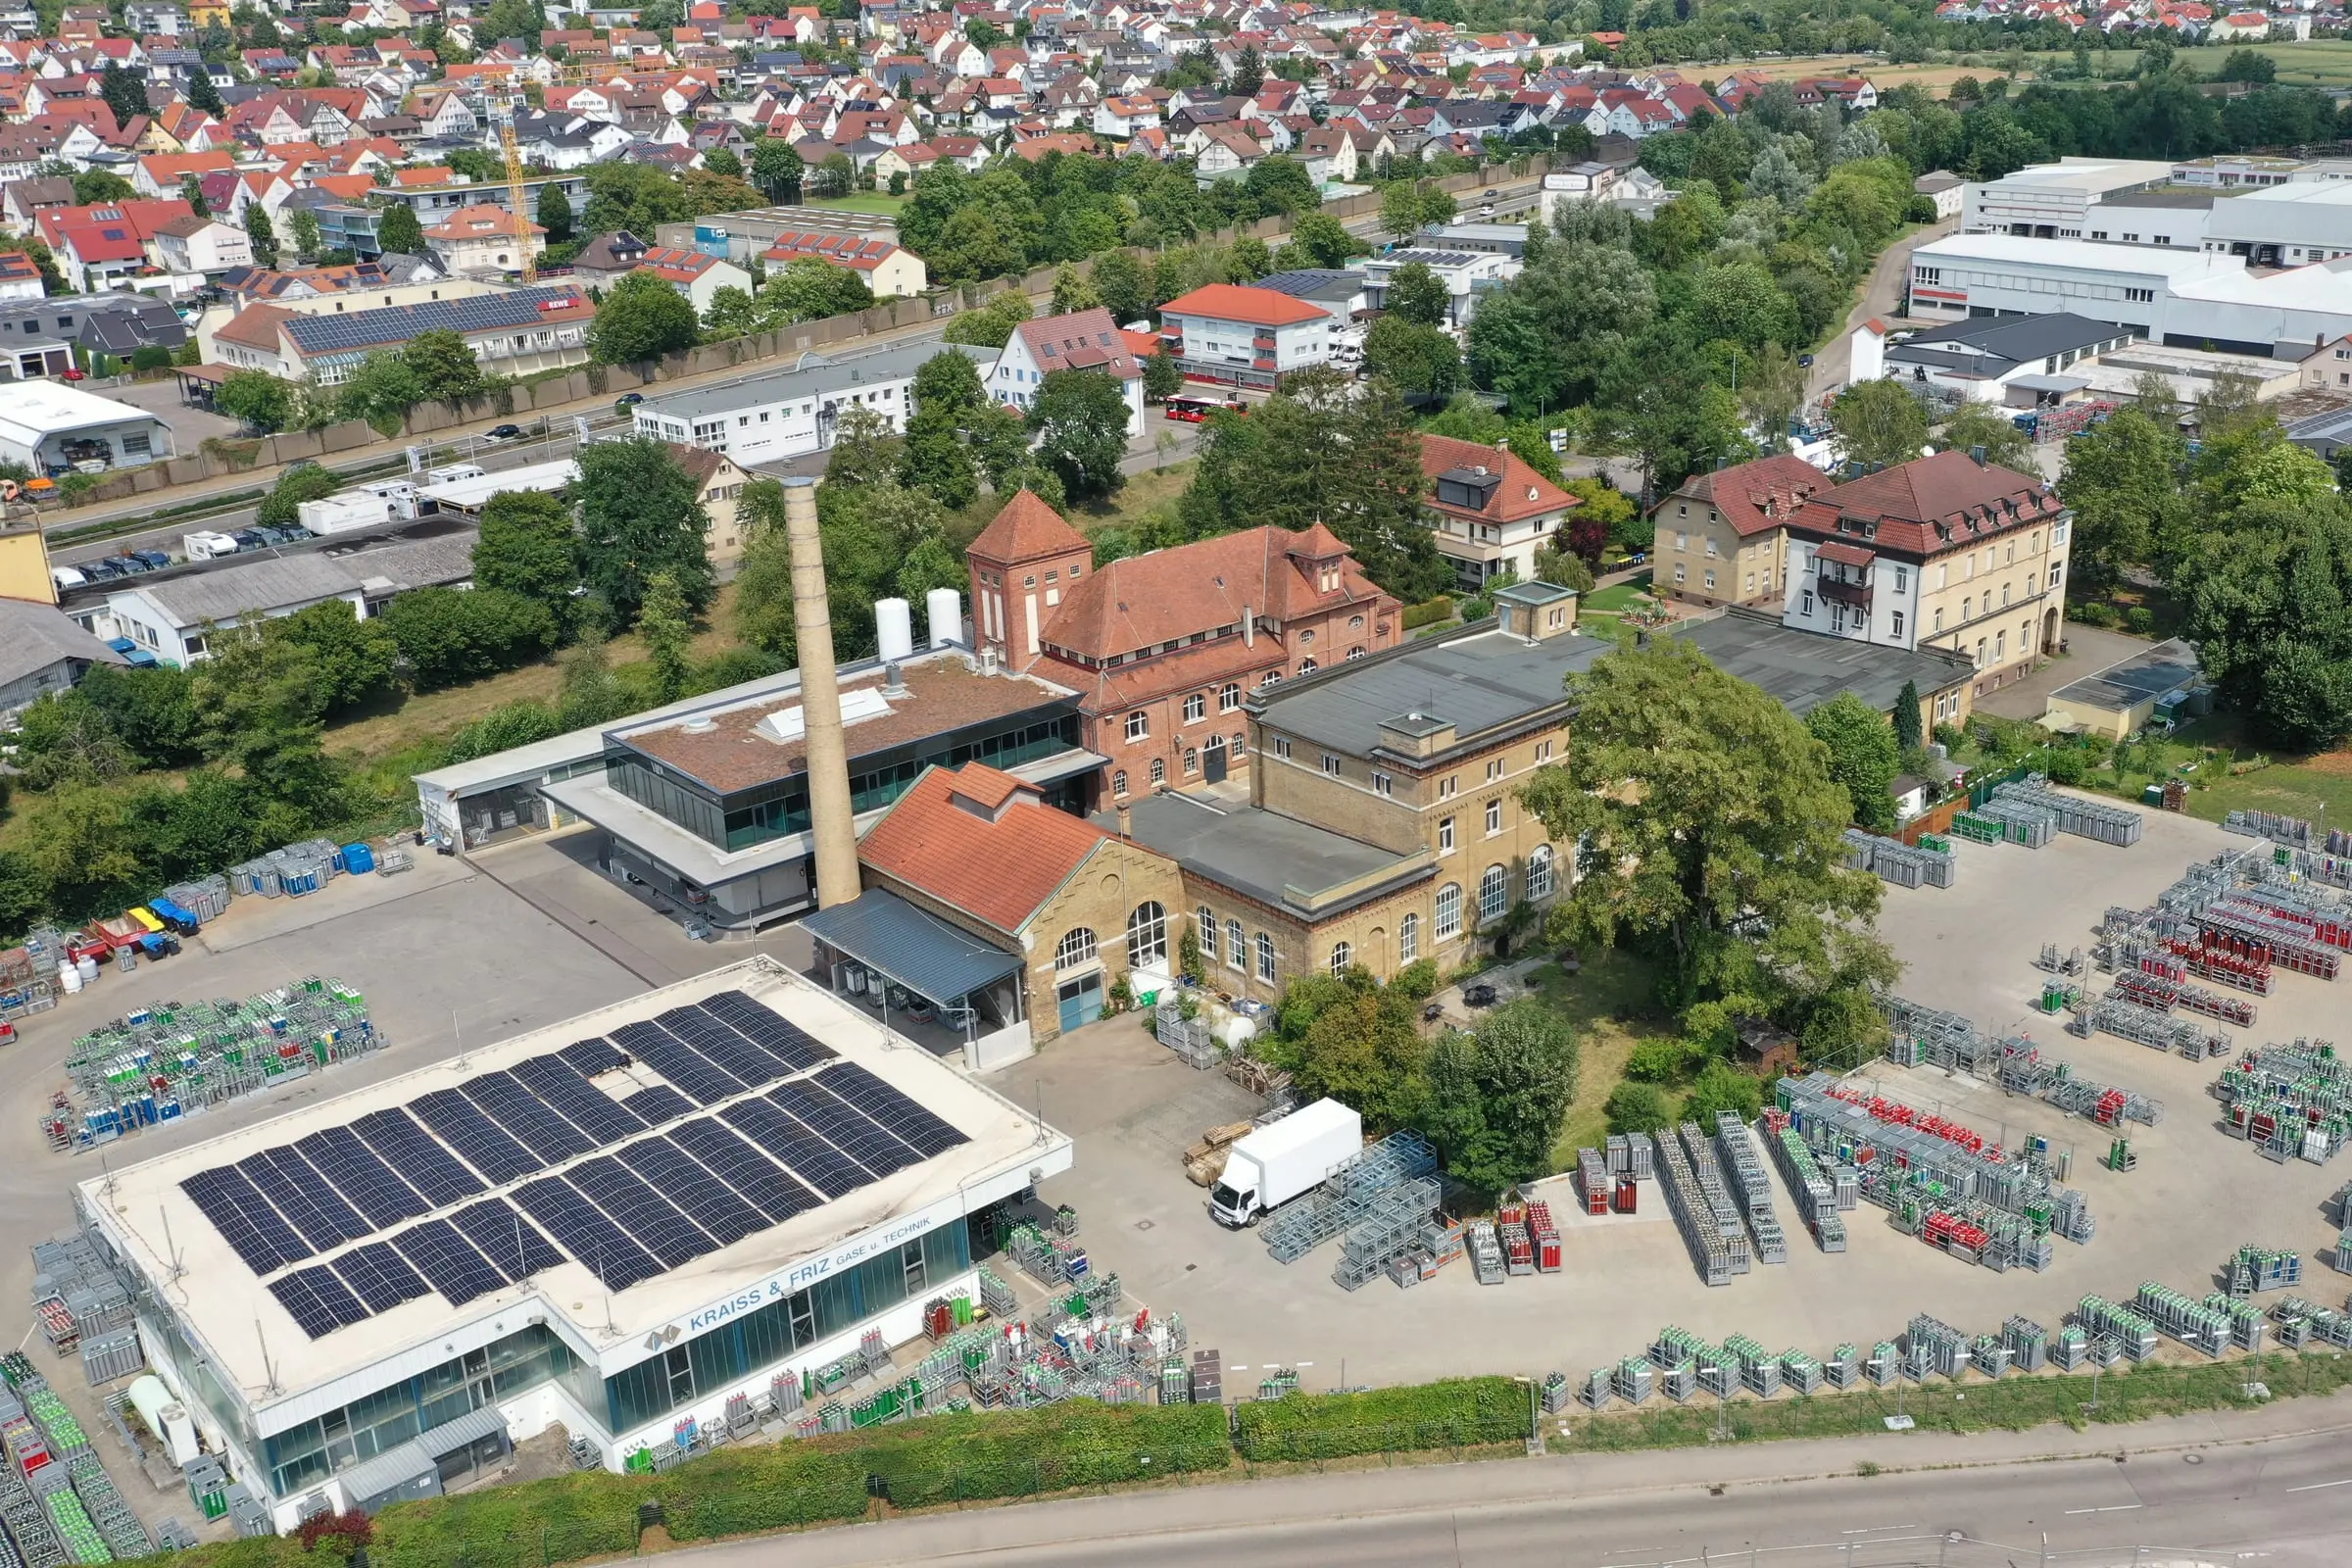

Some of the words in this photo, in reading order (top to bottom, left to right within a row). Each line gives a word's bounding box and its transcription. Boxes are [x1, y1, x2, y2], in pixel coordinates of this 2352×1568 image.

[549, 299, 569, 309] REWE
[690, 1289, 761, 1331] KRAISS
[769, 1281, 781, 1295] &
[790, 1257, 831, 1287] FRIZ
[836, 1245, 866, 1265] GASE
[883, 1216, 931, 1244] TECHNIK
